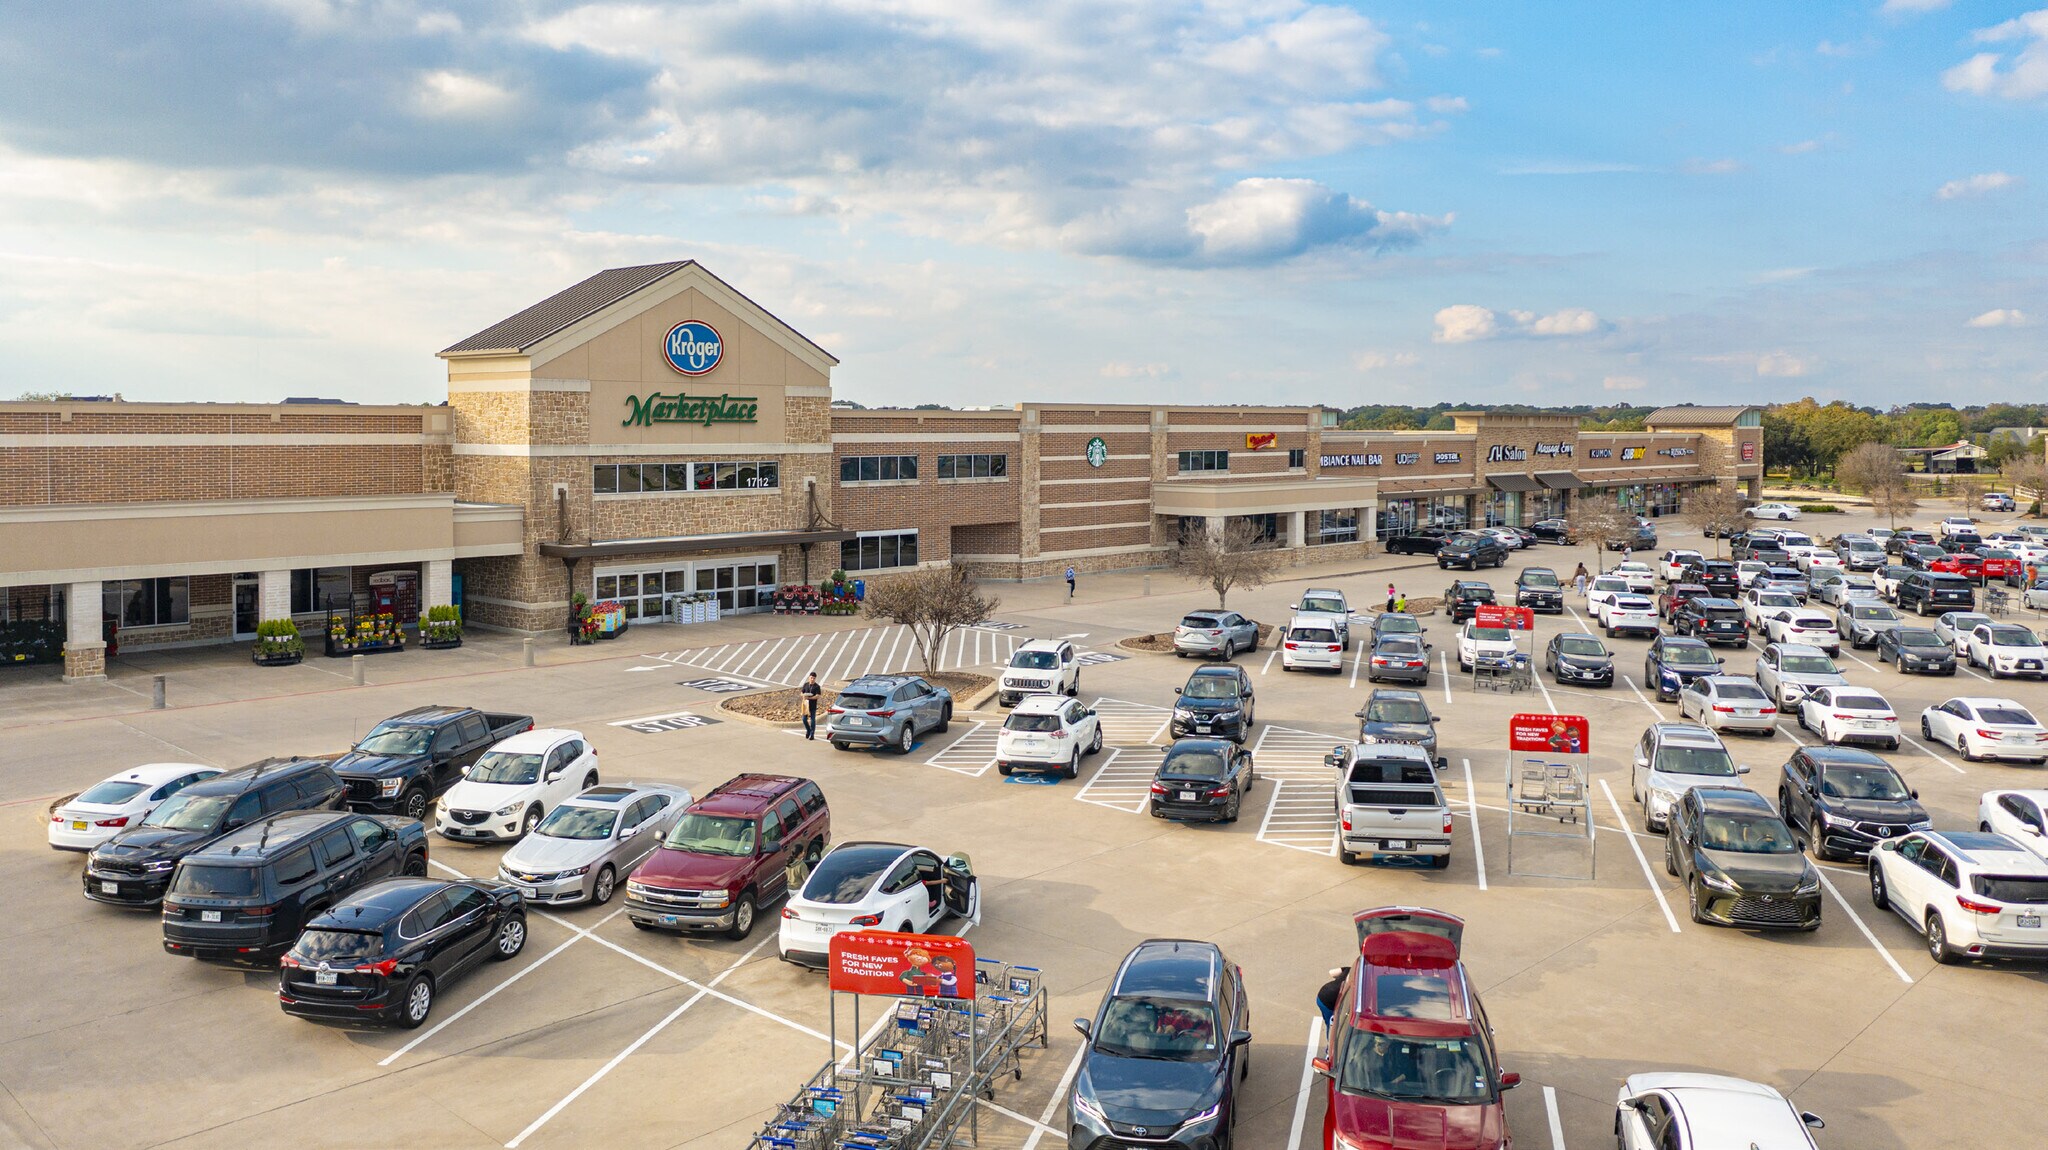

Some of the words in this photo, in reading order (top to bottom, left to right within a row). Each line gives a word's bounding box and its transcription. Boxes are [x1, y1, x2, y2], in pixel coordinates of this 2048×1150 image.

[671, 328, 720, 369] Kroger
[622, 392, 758, 427] Marketplace
[1504, 446, 1527, 460] Salon
[1591, 449, 1613, 458] KUMON
[1350, 454, 1367, 465] NAIL
[1368, 454, 1383, 465] BAR
[746, 477, 769, 487] 1712
[631, 716, 708, 733] STOP
[841, 951, 869, 961] FRESH
[871, 955, 899, 964] FAVES
[842, 959, 860, 967] FOR
[862, 962, 883, 970] NEW
[842, 966, 895, 977] TRADITIONS
